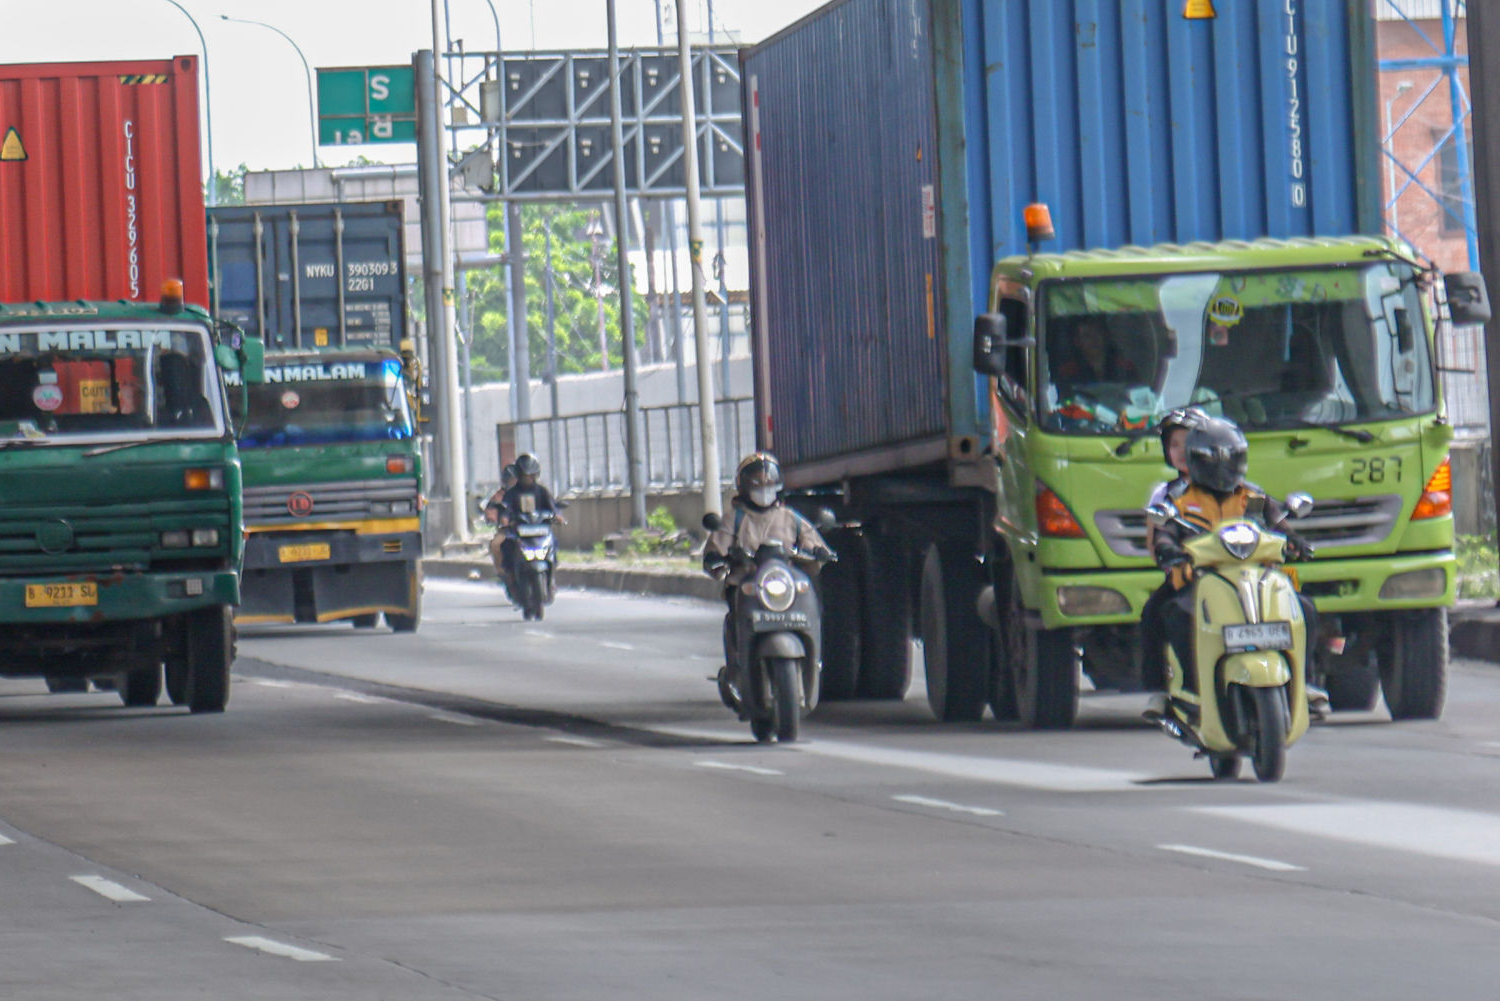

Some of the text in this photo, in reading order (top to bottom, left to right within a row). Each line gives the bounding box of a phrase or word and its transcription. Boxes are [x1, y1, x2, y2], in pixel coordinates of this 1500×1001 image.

[370, 75, 390, 101] S
[124, 120, 139, 299] CICU 329605
[306, 264, 334, 278] NYKU
[38, 330, 172, 351] MALAM
[283, 361, 365, 382] MALAM
[1350, 456, 1403, 485] 287
